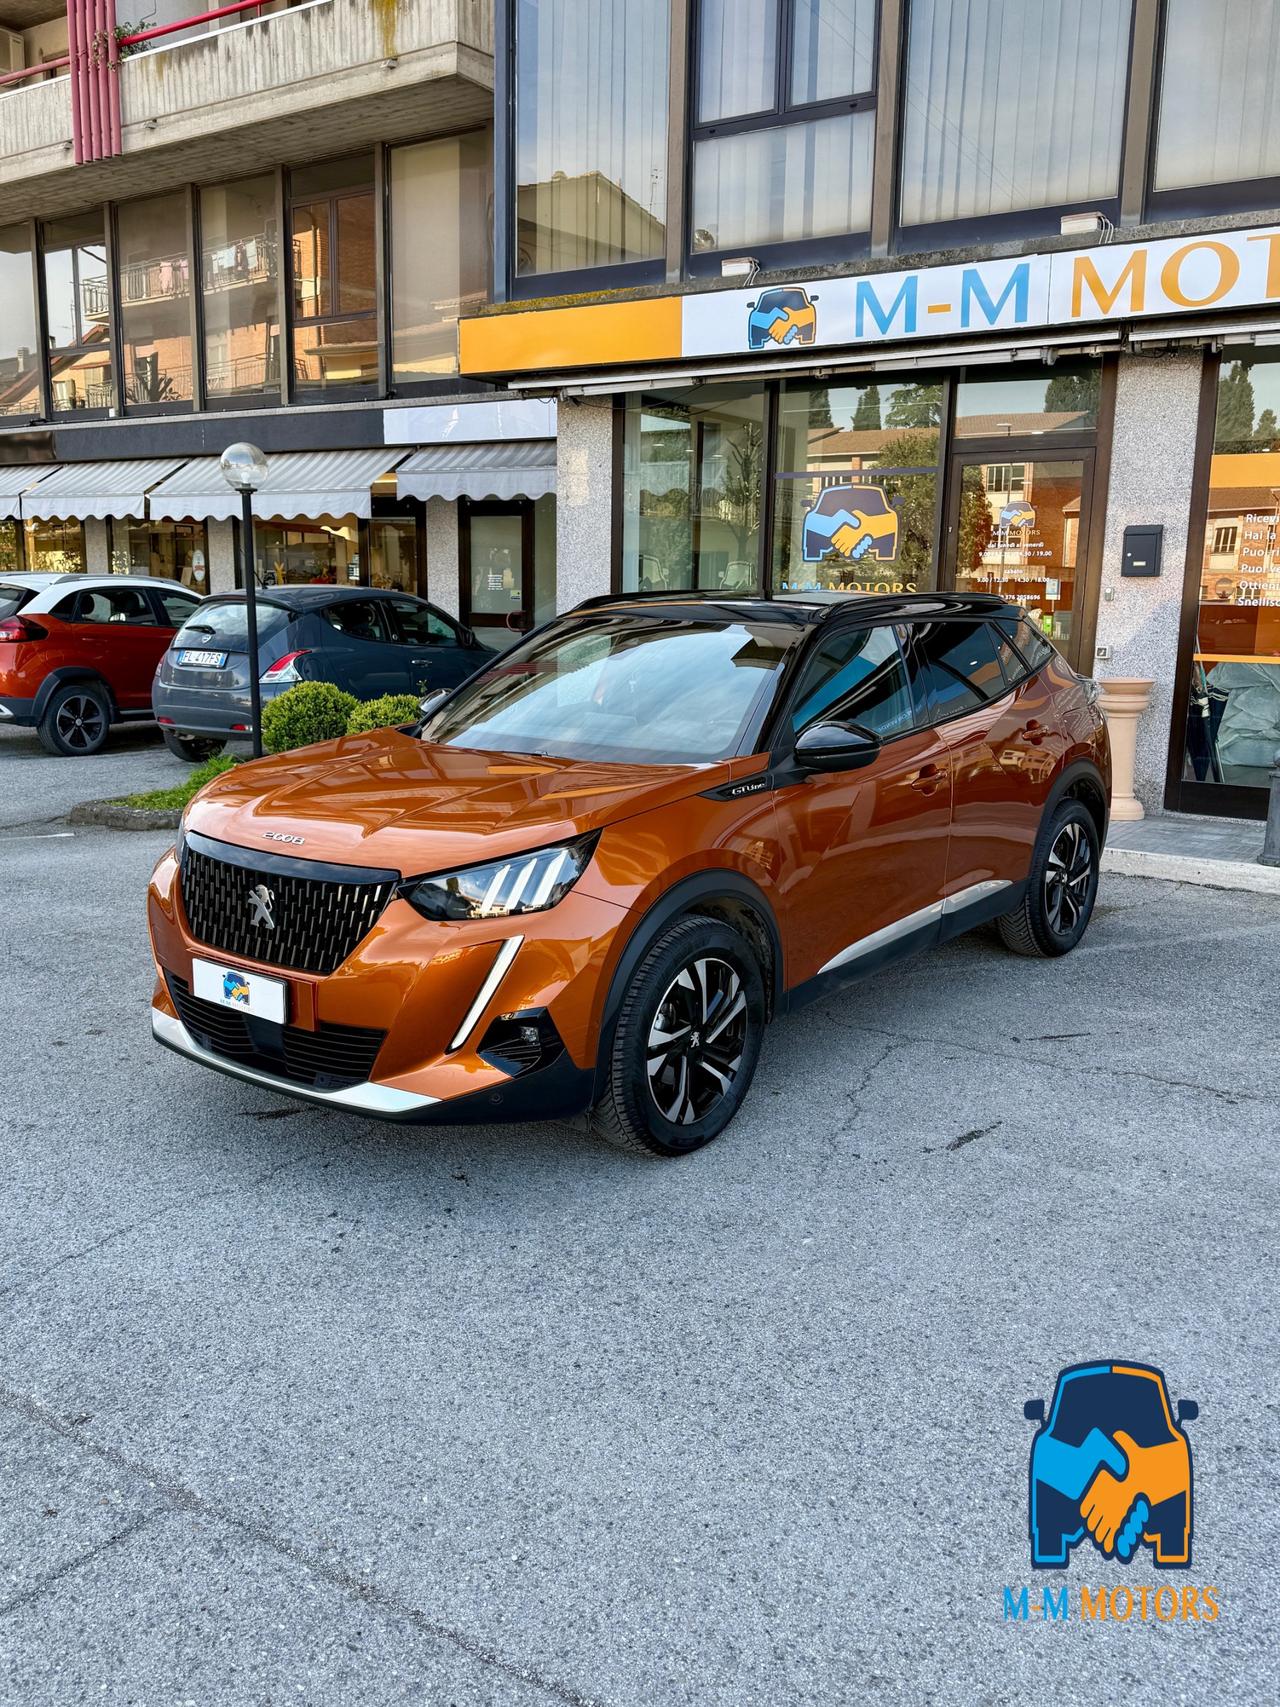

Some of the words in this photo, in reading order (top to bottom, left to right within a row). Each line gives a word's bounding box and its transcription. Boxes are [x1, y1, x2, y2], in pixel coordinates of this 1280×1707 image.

[855, 262, 1030, 338] M-M
[1244, 530, 1263, 540] Hai
[1243, 547, 1267, 557] Puo
[261, 831, 305, 845] 2008
